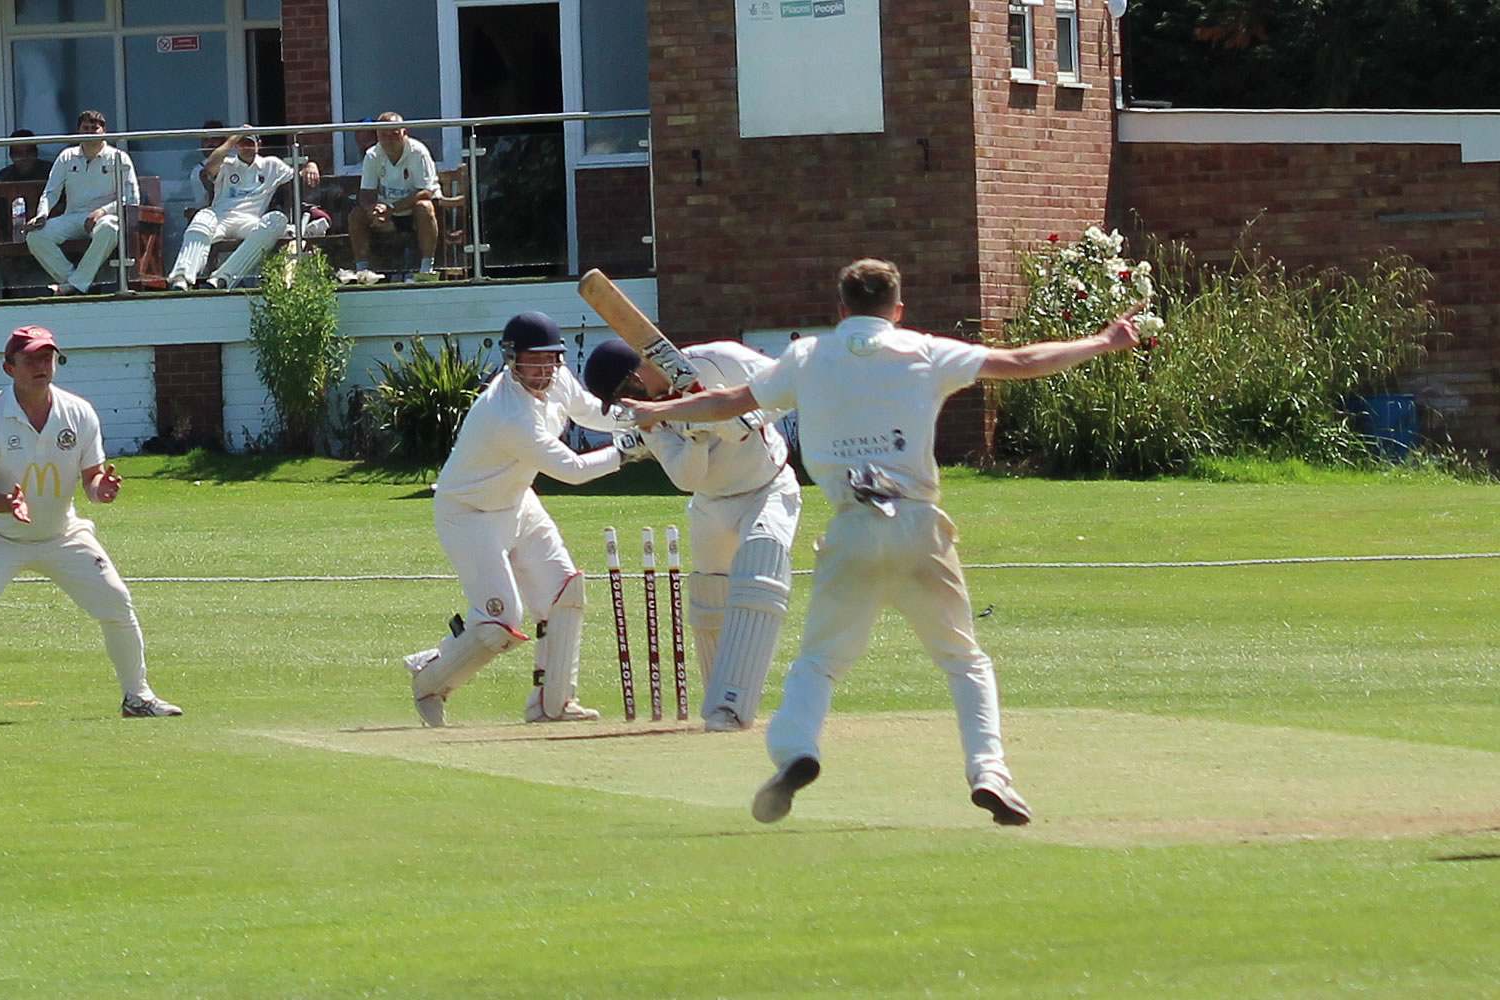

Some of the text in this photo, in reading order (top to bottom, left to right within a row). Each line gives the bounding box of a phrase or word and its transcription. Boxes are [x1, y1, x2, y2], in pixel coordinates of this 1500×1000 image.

[814, 2, 844, 14] People
[832, 434, 888, 448] CAYMAN
[610, 573, 634, 714] WORCESTER NOMADS
[645, 573, 662, 715] WORCESTER NOMADS
[670, 573, 688, 714] WORCESTER NOMADS
